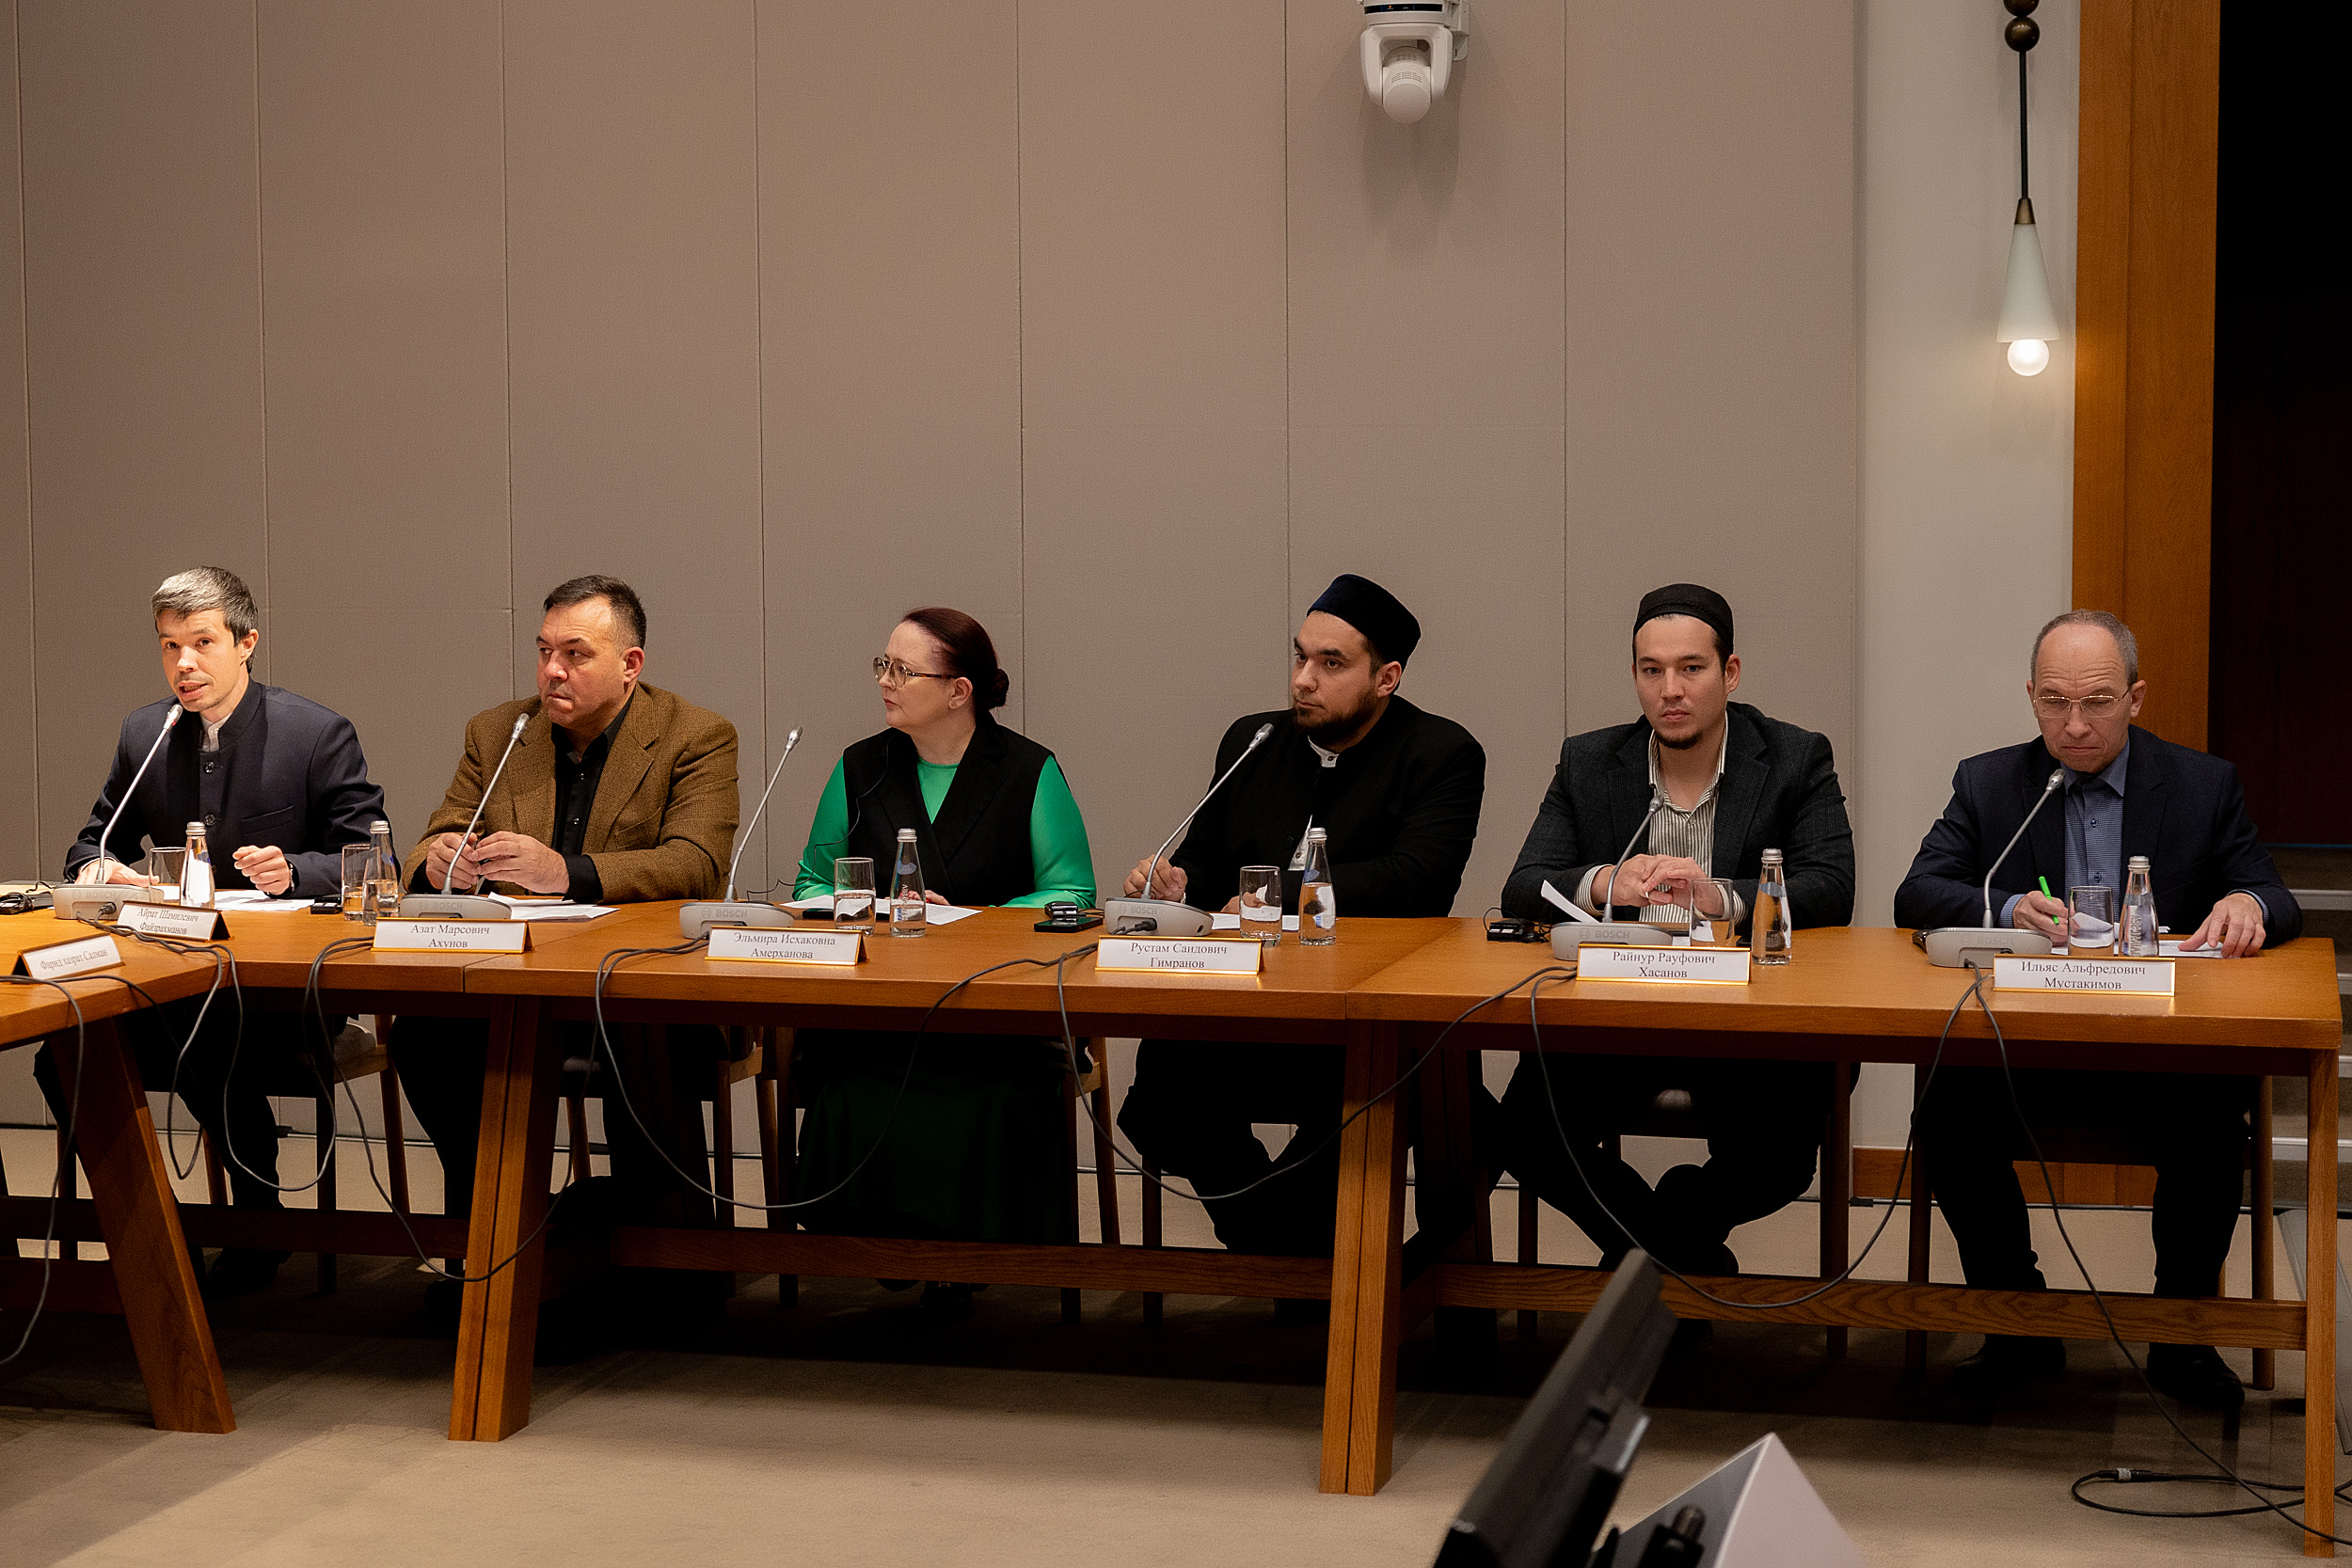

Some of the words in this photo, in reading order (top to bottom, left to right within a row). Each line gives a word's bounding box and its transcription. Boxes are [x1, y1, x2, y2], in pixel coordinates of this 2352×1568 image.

[86, 891, 117, 899] BOSCH
[433, 902, 463, 911] BOSCH
[1130, 906, 1158, 915] BOSCH
[137, 908, 158, 920] Айрат
[158, 909, 199, 923] Шамилевич
[715, 909, 748, 918] BOSCH
[139, 922, 188, 935] Файзрахманов
[410, 925, 436, 934] Азат
[437, 925, 490, 936] Марсович
[1595, 929, 1630, 940] BOSCH
[428, 938, 469, 949] Ахунов
[734, 932, 778, 944] Эльмира
[780, 934, 835, 945] Исхаковна
[83, 949, 108, 960] Салман
[750, 947, 814, 959] Амерханова
[1131, 942, 1169, 955] Рустам
[1172, 943, 1228, 955] Саидович
[1150, 957, 1205, 969] Гимранов
[1612, 951, 1655, 964] Райнур
[1658, 952, 1716, 966] Рауфович
[1638, 966, 1688, 978] Хасанов
[2021, 960, 2058, 973] Ильяс
[2061, 962, 2146, 975] Альфредович
[2043, 977, 2122, 990] Мустакимов
